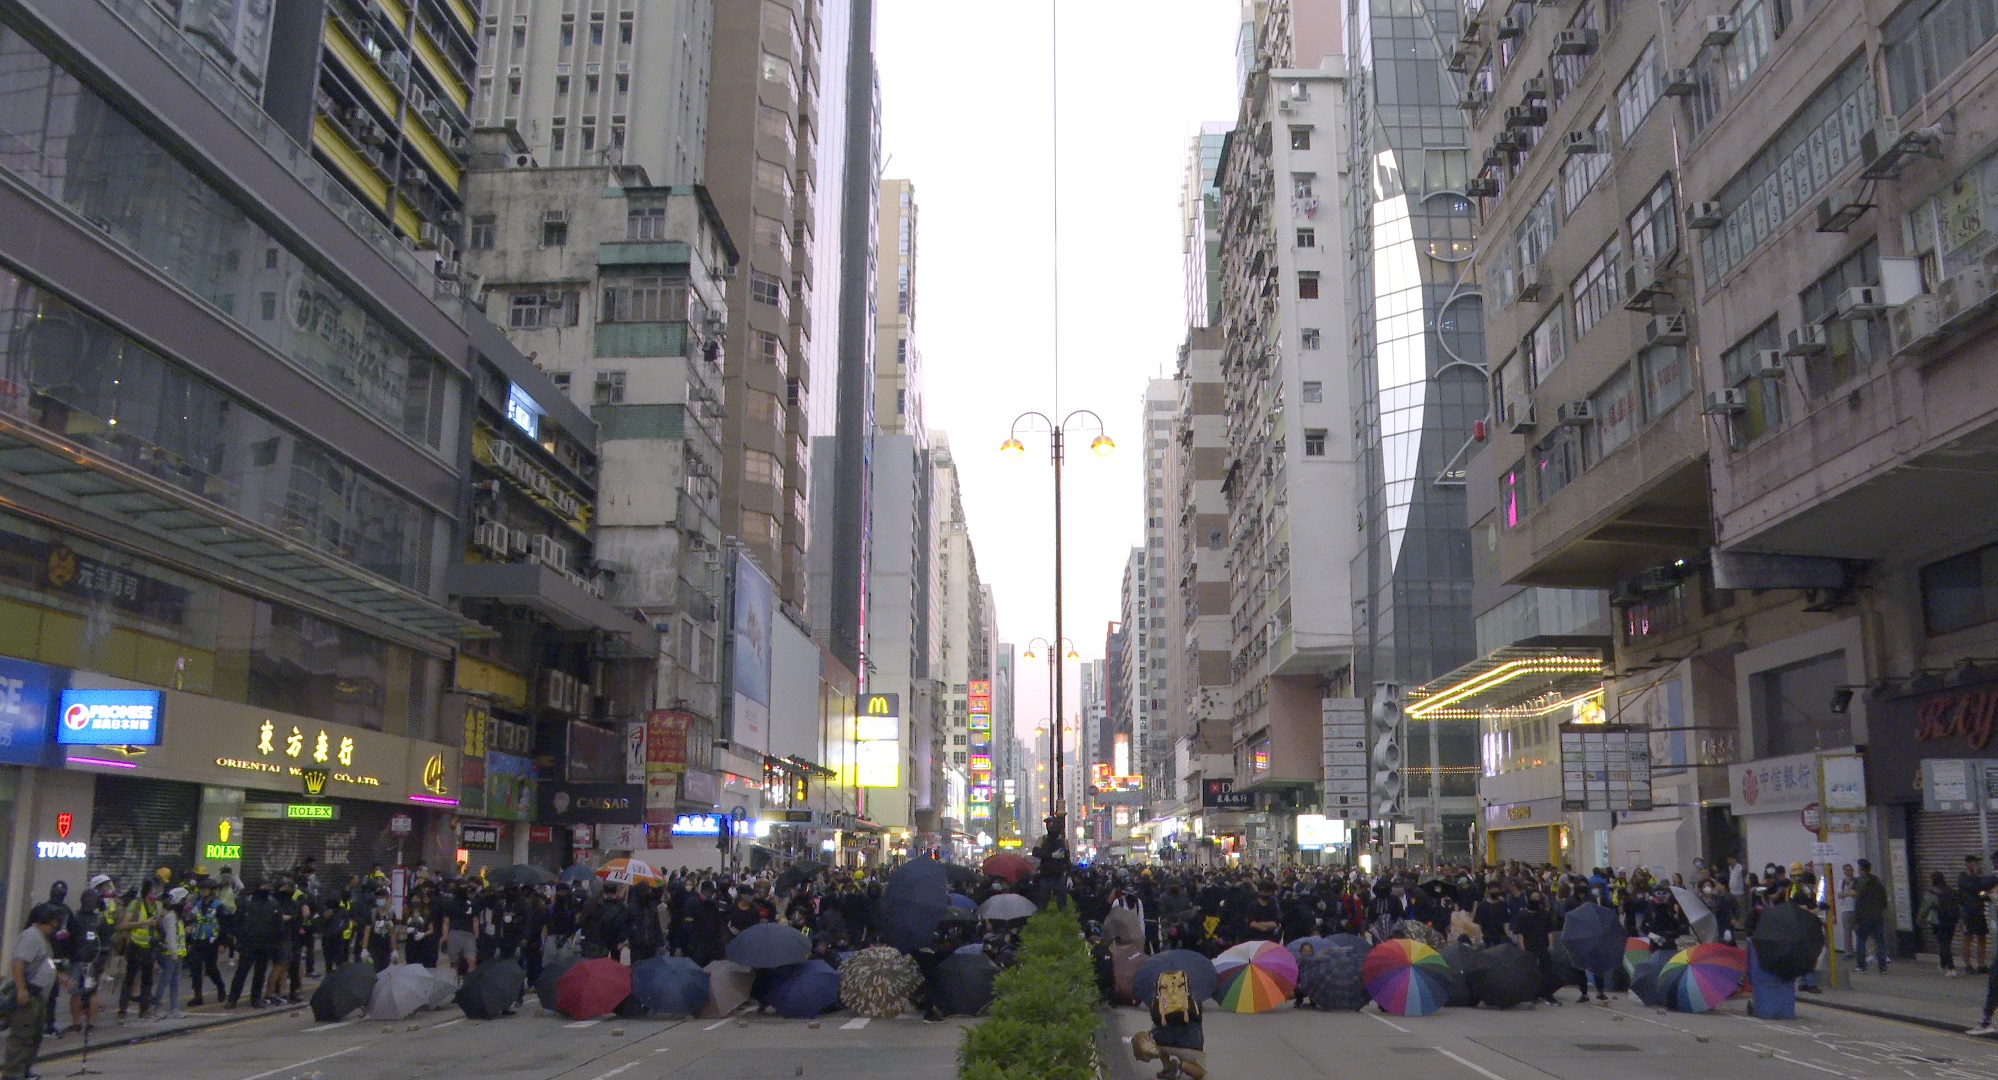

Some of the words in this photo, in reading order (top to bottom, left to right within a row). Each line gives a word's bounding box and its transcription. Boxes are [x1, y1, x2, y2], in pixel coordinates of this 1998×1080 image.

[90, 705, 153, 719] PROMISE
[257, 719, 354, 766] 東方表行
[1759, 763, 1810, 791] 中信銀行
[576, 798, 629, 809] CAESAR
[289, 806, 331, 816] ROLEX
[37, 842, 86, 858] TUDOR
[206, 844, 240, 858] ROLEX
